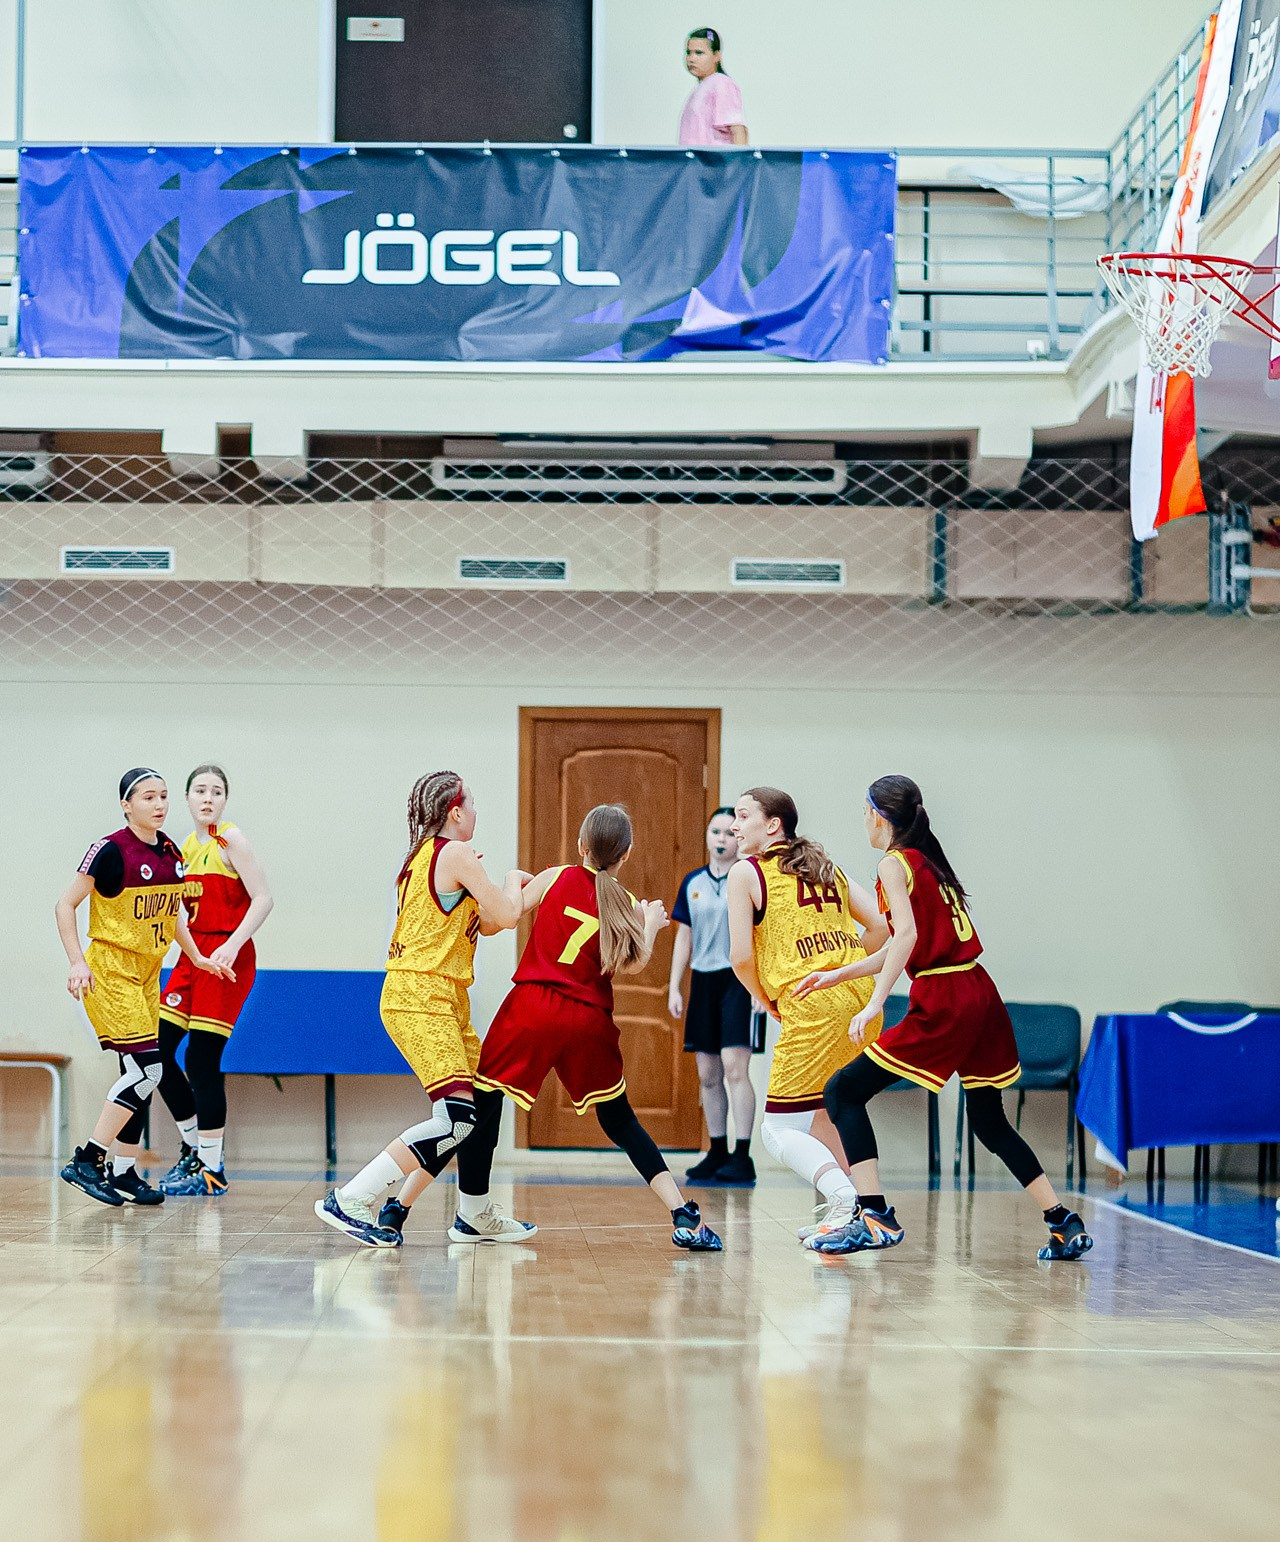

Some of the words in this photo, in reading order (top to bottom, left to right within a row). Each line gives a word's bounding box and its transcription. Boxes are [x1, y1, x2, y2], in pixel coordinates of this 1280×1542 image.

[302, 212, 620, 286] JÖGEL
[797, 875, 842, 914] 44
[151, 922, 167, 948] 74
[557, 905, 600, 965] 7
